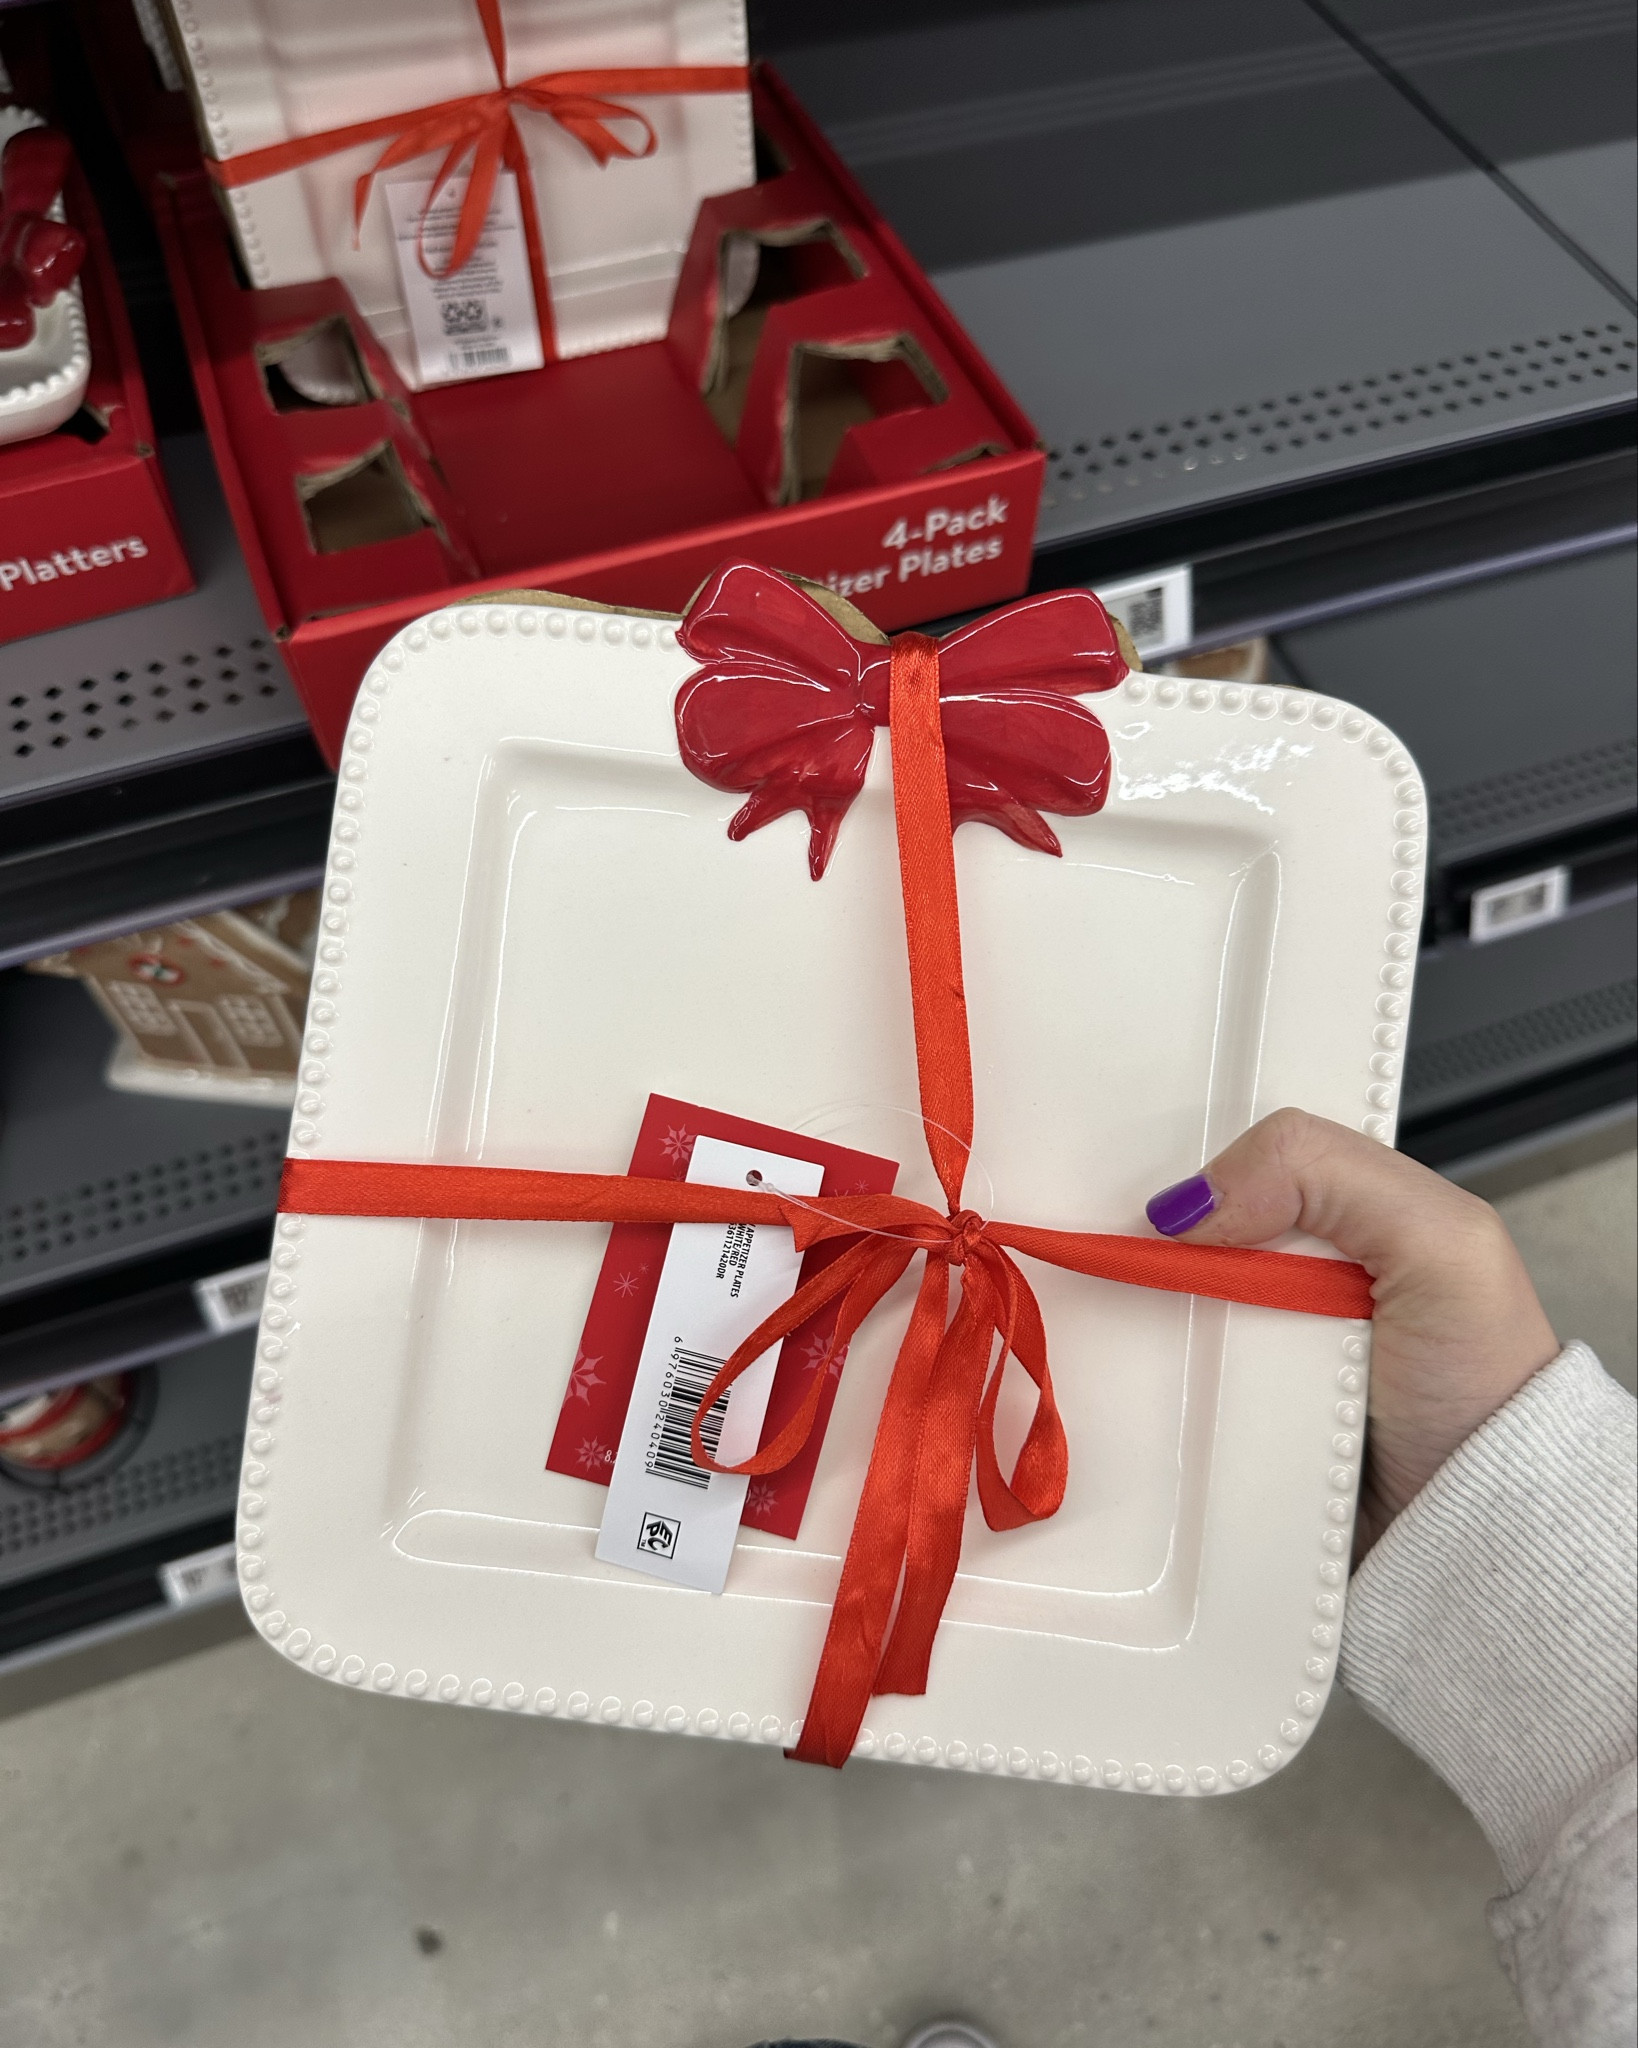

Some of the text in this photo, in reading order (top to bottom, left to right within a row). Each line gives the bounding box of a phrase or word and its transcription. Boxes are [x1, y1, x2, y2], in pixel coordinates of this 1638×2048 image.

[882, 495, 1010, 550] 4-Pack
[0, 535, 149, 591] Platters
[814, 535, 1004, 598] izer Plates
[716, 1222, 737, 1280] 361121420DR
[729, 1223, 747, 1266] WHITE/RED
[737, 1226, 754, 1269] APPETIZER
[730, 1269, 744, 1298] PLATES
